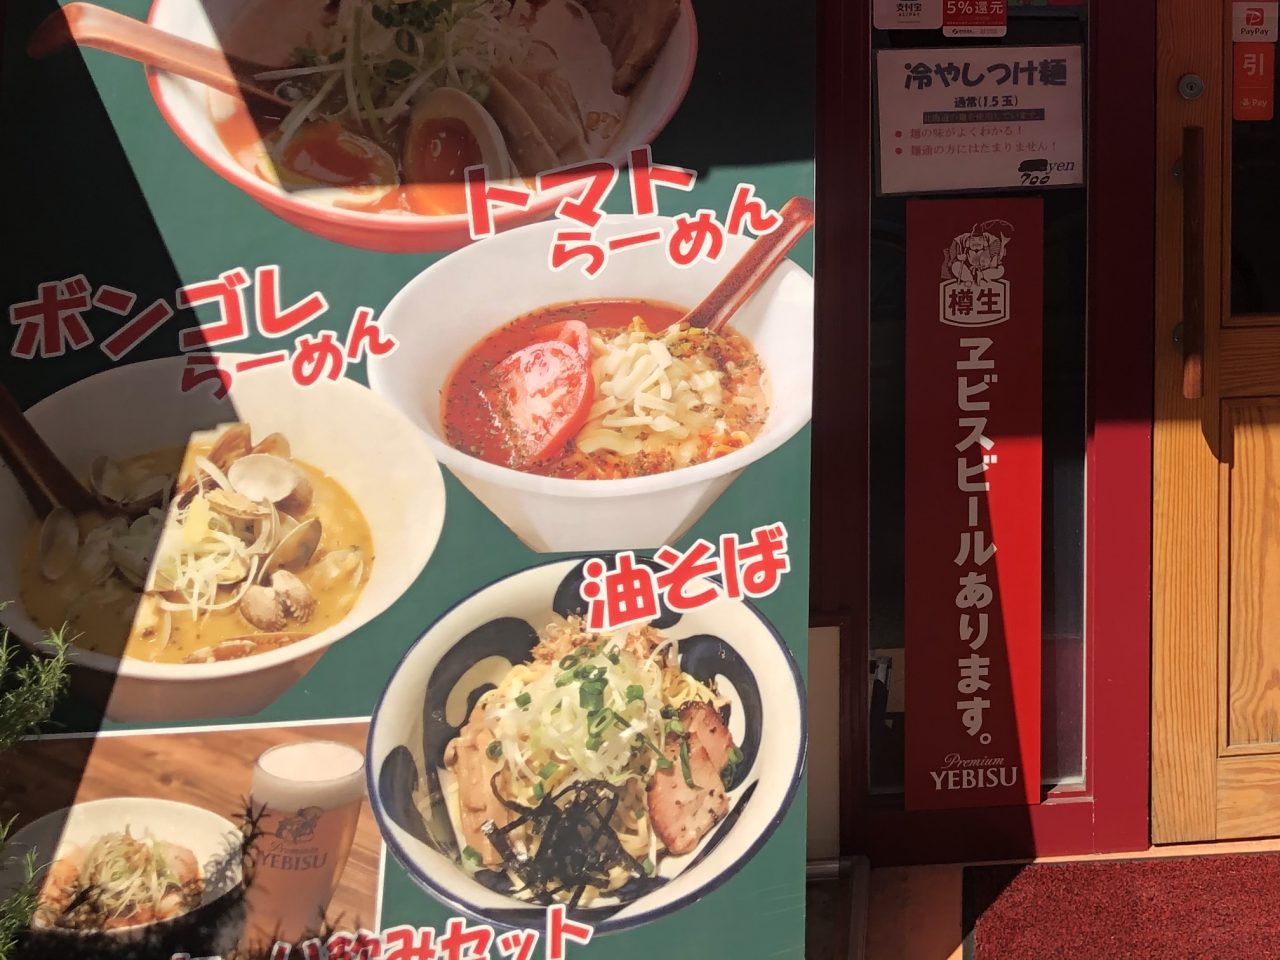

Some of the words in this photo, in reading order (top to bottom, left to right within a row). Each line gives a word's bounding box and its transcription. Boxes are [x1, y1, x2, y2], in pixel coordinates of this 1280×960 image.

[947, 0, 1004, 16] 5%還元
[1240, 27, 1269, 36] PayPay
[904, 59, 1067, 89] 冷やしつけ麺
[1020, 172, 1052, 185] 700
[1048, 159, 1075, 174] yen
[462, 144, 697, 240] トマト
[550, 183, 783, 279] らーめん
[9, 264, 330, 362] ボンゴレ
[948, 289, 1002, 316] 樽生
[178, 306, 399, 401] らーめん
[578, 521, 792, 632] 油そば
[941, 753, 1004, 768] Premium
[930, 767, 1017, 790] YEBISU
[258, 851, 329, 871] YEBISU
